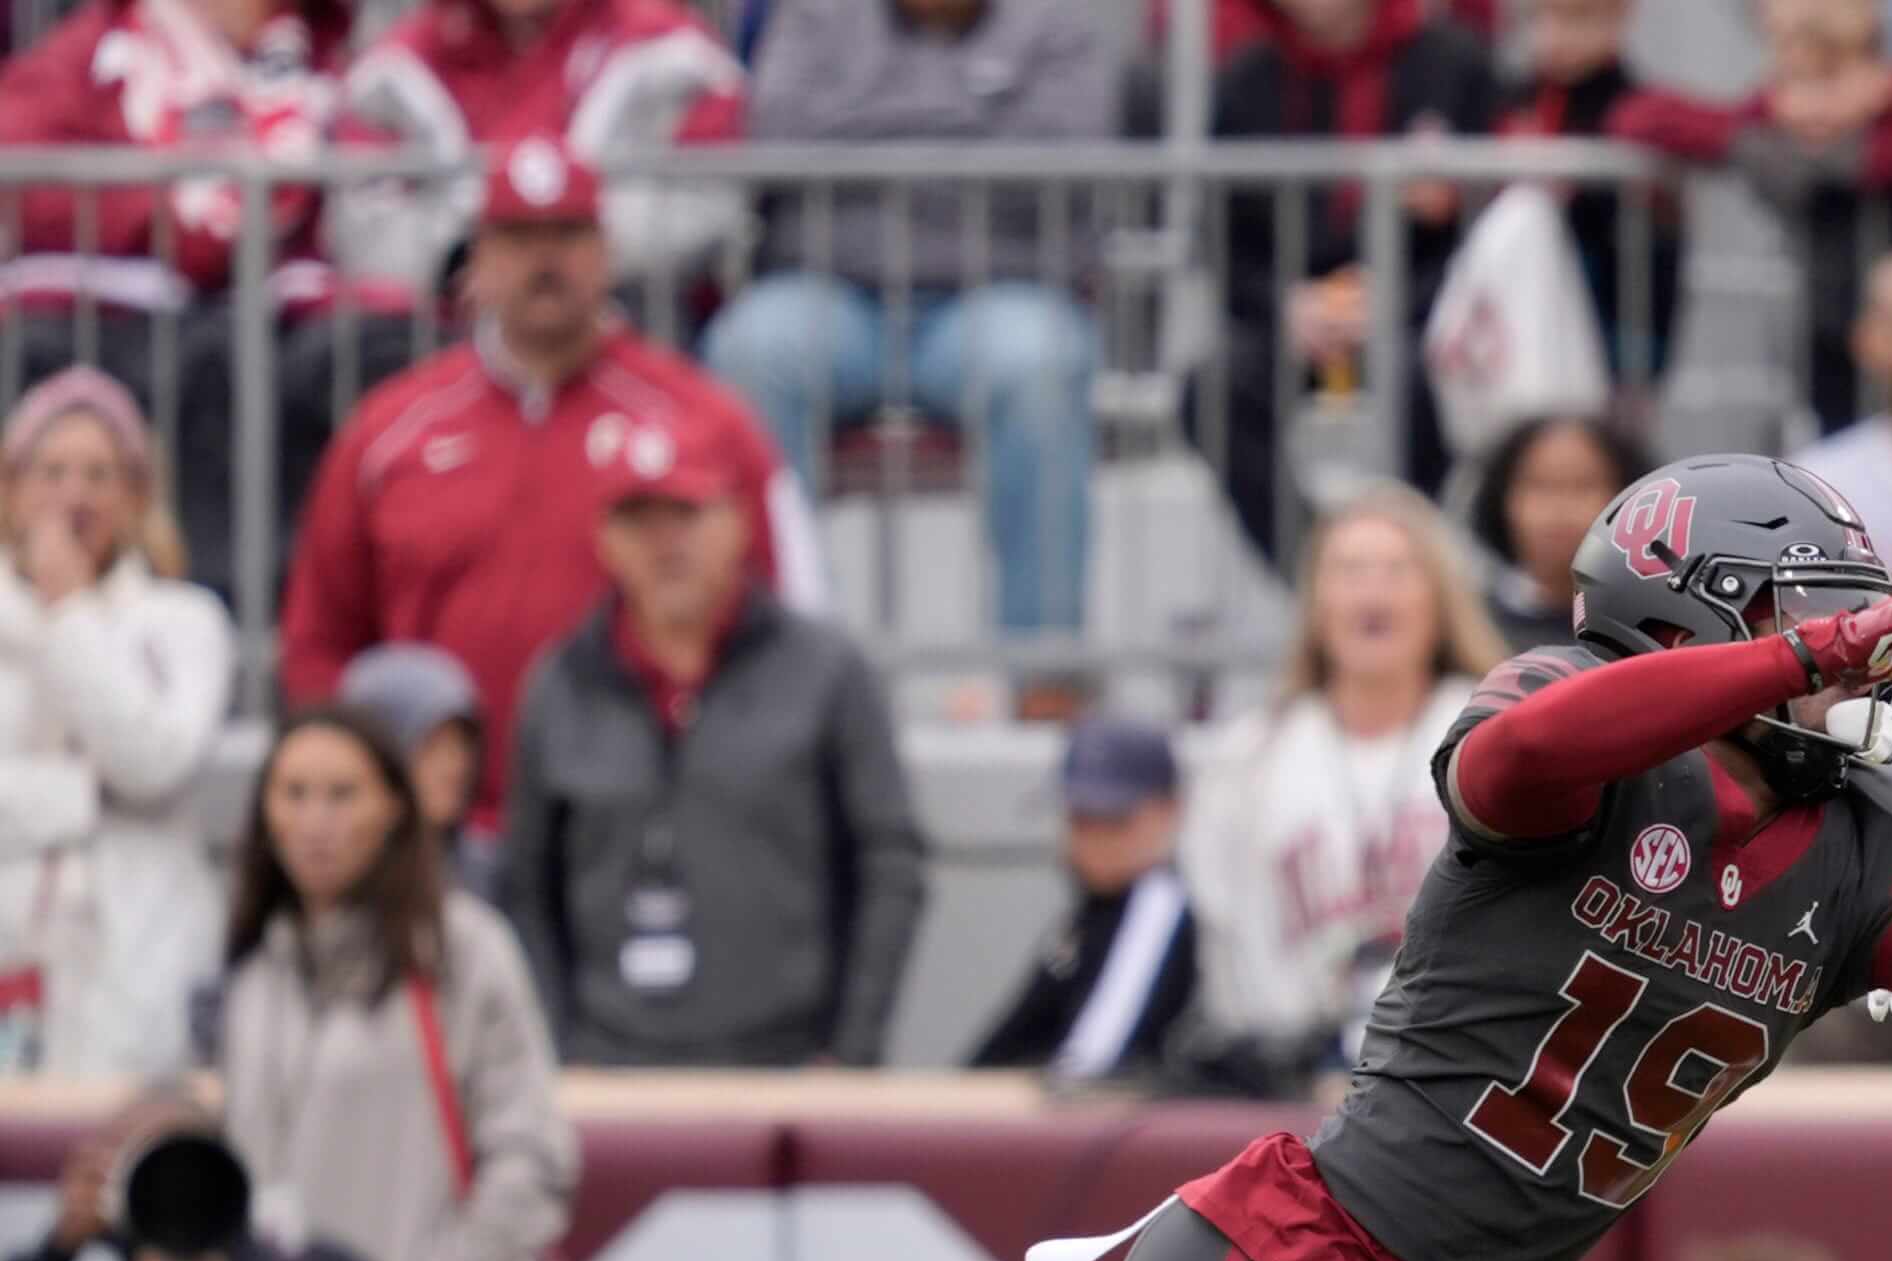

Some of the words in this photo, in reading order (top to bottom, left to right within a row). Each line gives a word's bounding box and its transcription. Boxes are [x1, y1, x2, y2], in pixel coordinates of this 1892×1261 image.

[1611, 478, 1696, 579] OU
[1634, 829, 1688, 888] SEC
[1720, 864, 1743, 907] OU
[1463, 949, 1770, 1209] 19
